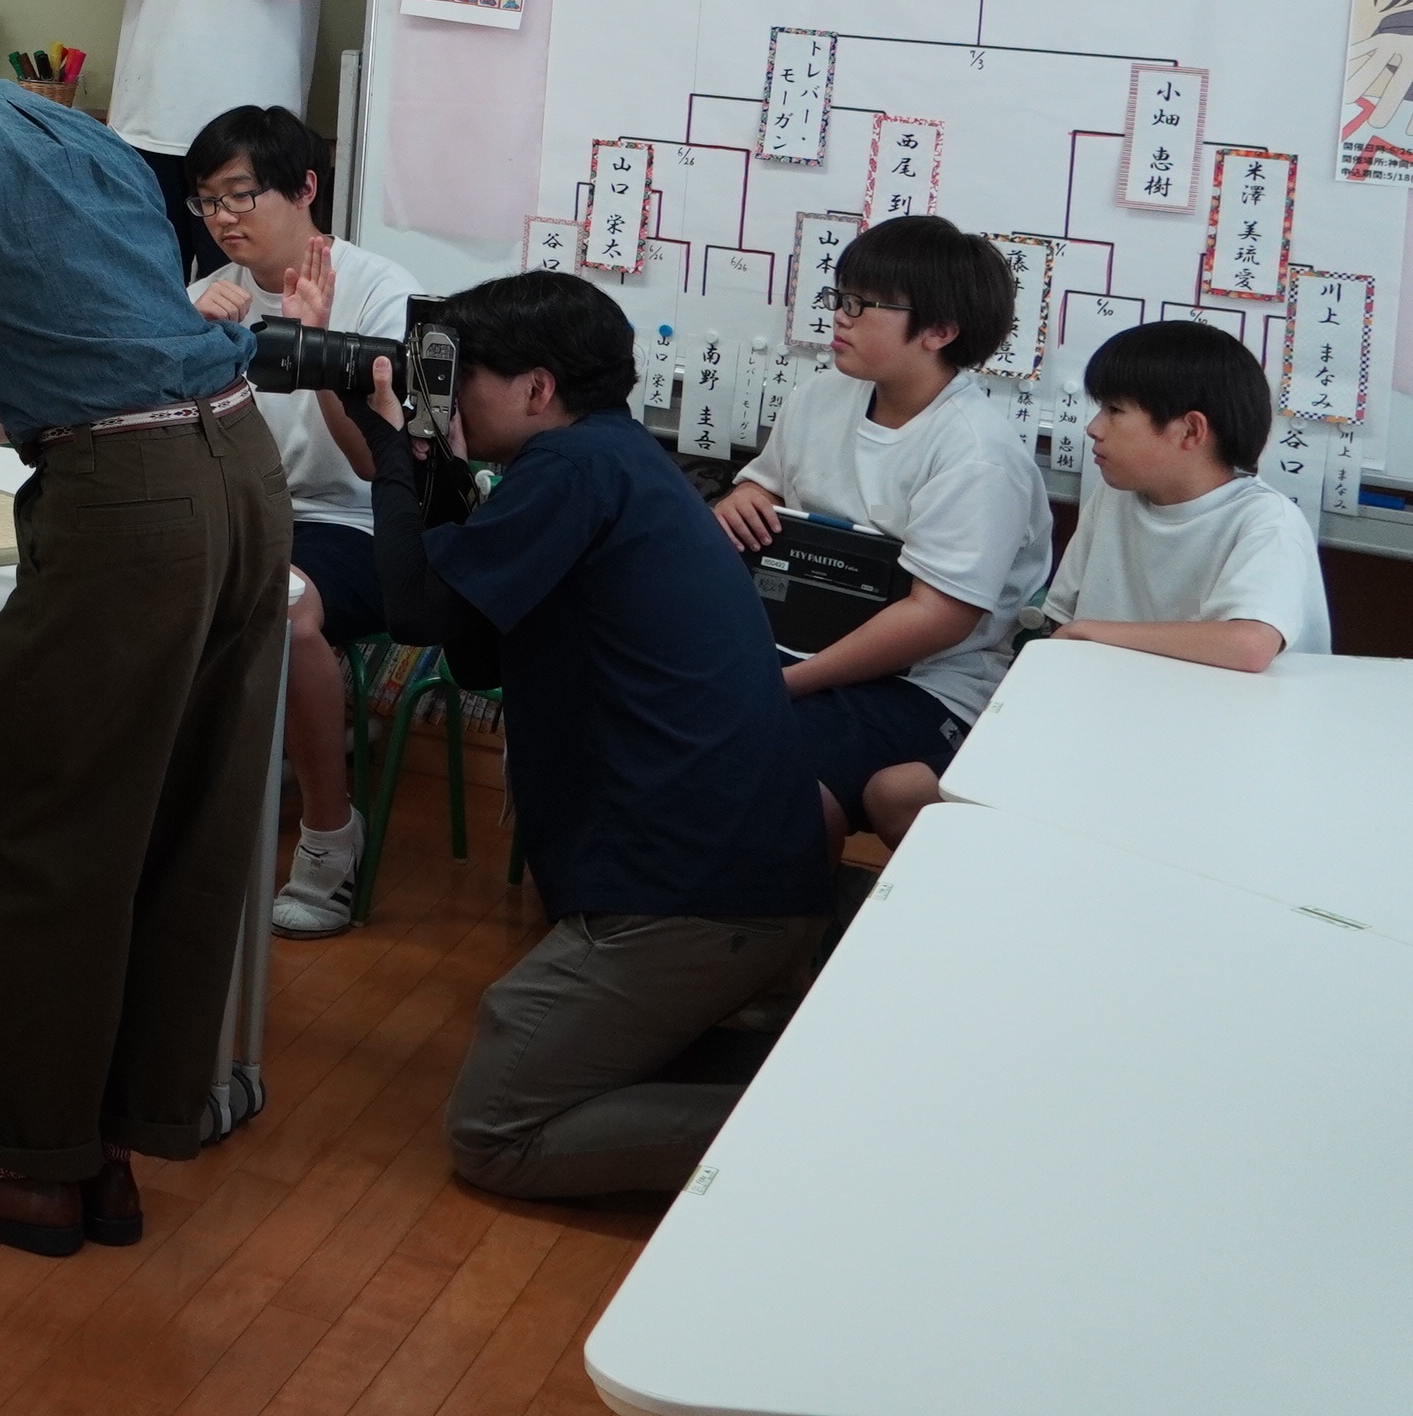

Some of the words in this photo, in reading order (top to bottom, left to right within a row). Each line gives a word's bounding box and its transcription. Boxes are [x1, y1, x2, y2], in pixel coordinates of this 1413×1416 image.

[773, 68, 795, 151] モーガン
[1152, 81, 1181, 128] 小畑
[610, 157, 632, 195] 山口
[890, 134, 919, 178] 西尾
[1144, 146, 1175, 198] 恵樹
[1240, 160, 1267, 205] 米澤
[542, 232, 564, 271] 谷口
[601, 214, 626, 259] 栄太
[817, 230, 840, 273] 山本
[1233, 220, 1264, 291] 美琉愛
[1319, 282, 1342, 327] 川上
[655, 337, 670, 362] 山口
[699, 344, 721, 391] 南野
[773, 356, 788, 384] 山本
[649, 373, 666, 404] 栄太
[1310, 343, 1335, 410] まなみ
[694, 406, 716, 450] 圭吾
[1059, 392, 1078, 425] 小畑
[1057, 437, 1075, 469] 恵樹
[1279, 429, 1309, 474] 谷口
[1337, 431, 1354, 460] 川上
[1334, 468, 1349, 509] まなみ
[790, 549, 807, 561] KEY
[808, 555, 845, 569] PALETTO
